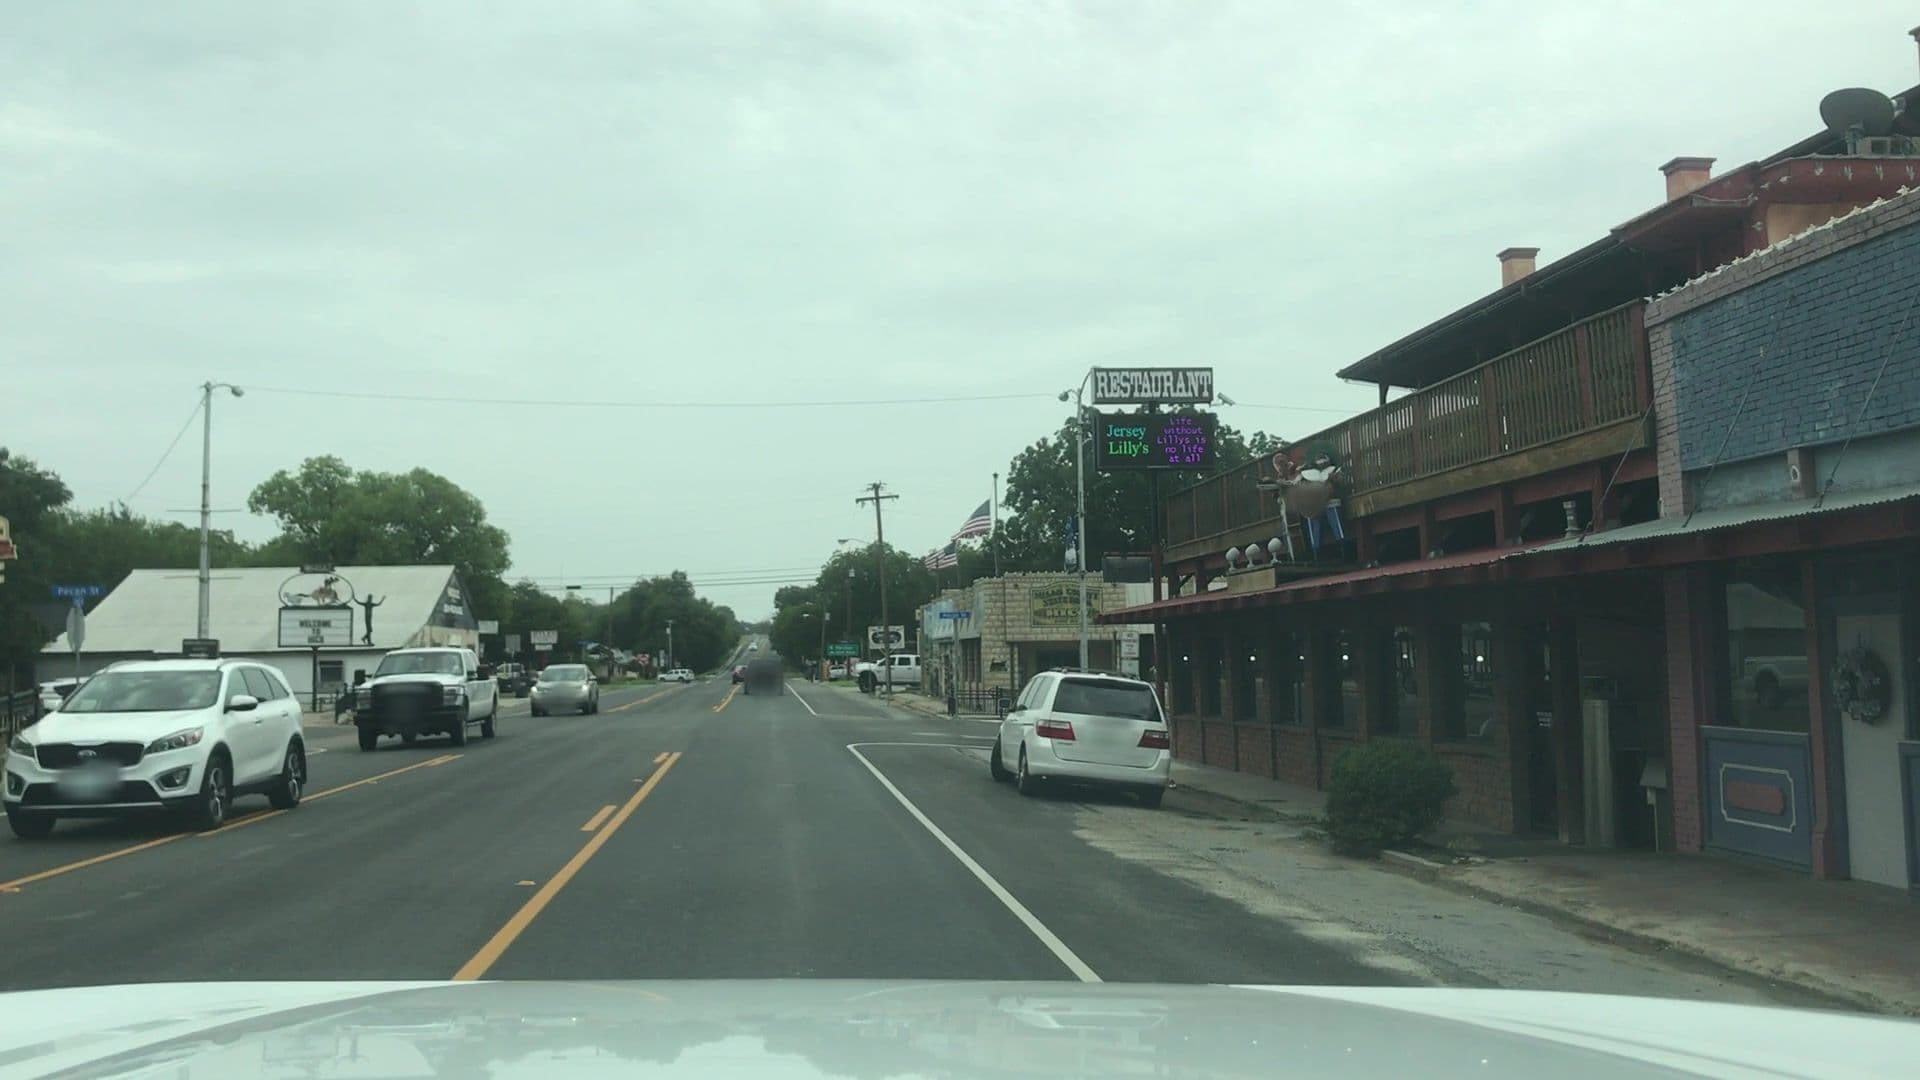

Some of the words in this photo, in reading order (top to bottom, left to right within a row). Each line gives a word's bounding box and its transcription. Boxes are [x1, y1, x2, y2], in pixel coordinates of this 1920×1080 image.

[1096, 371, 1211, 398] RESTAURANT
[1107, 425, 1146, 439] Jersey
[1163, 426, 1203, 434] without
[1195, 436, 1206, 444] is
[1109, 441, 1149, 457] Lilly's
[1165, 446, 1177, 454] no
[1182, 445, 1204, 453] life
[1168, 455, 1180, 463] at
[1185, 454, 1201, 462] all
